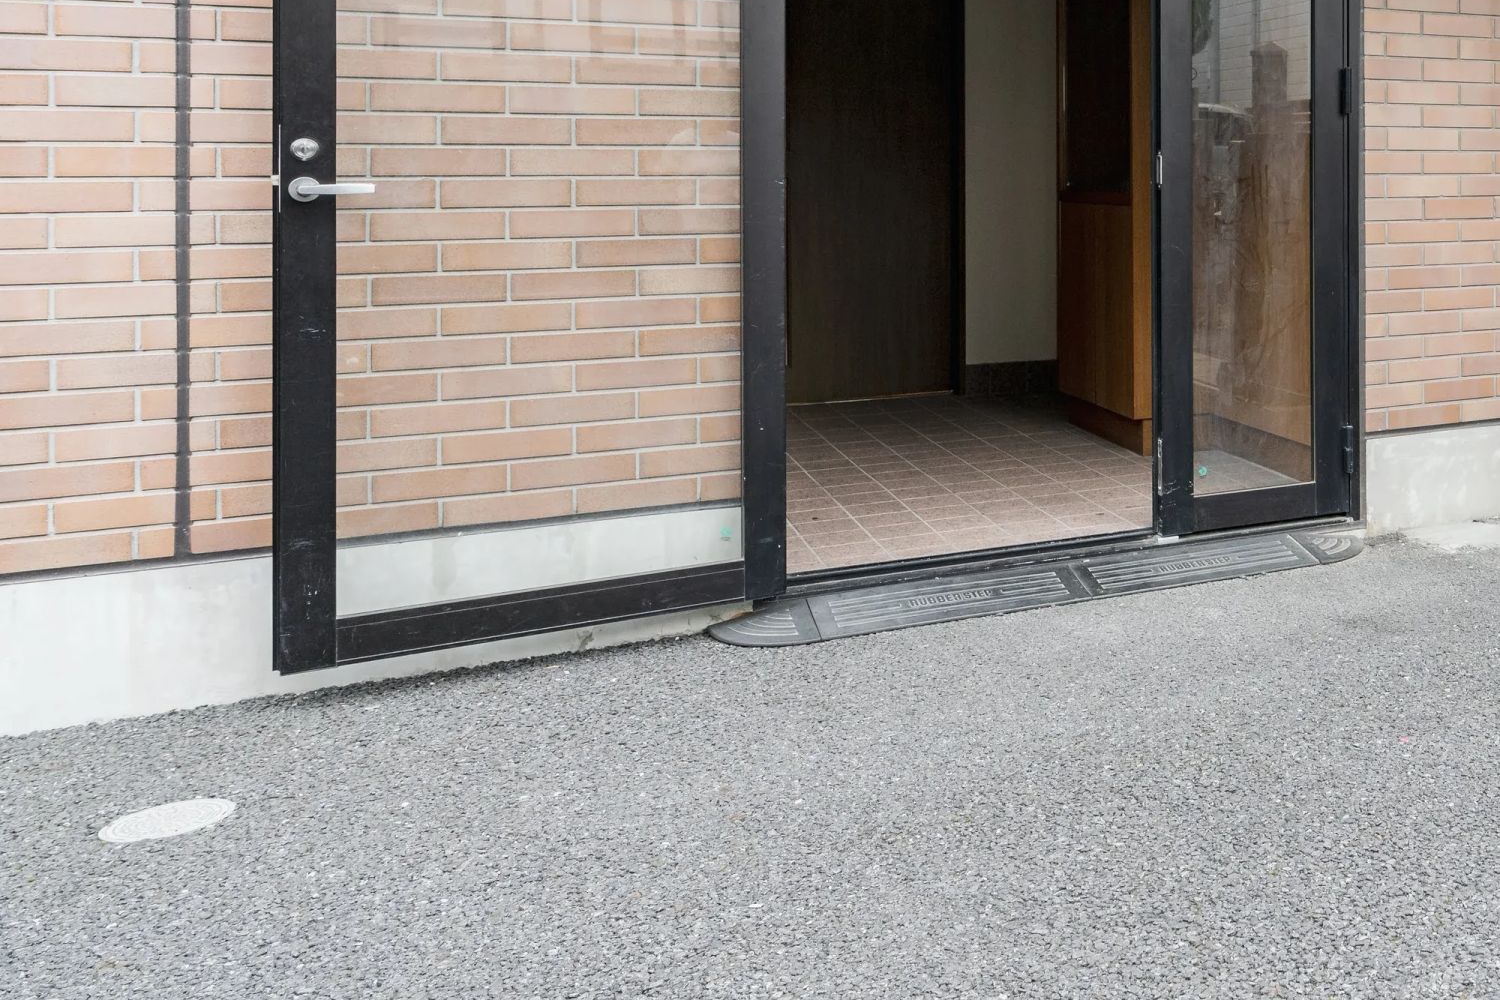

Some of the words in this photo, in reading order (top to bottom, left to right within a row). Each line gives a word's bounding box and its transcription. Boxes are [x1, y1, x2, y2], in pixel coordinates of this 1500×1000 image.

[1159, 559, 1205, 573] RUBBER
[1205, 556, 1232, 567] STEP
[908, 593, 963, 608] RUBBER
[964, 589, 993, 600] STEP
